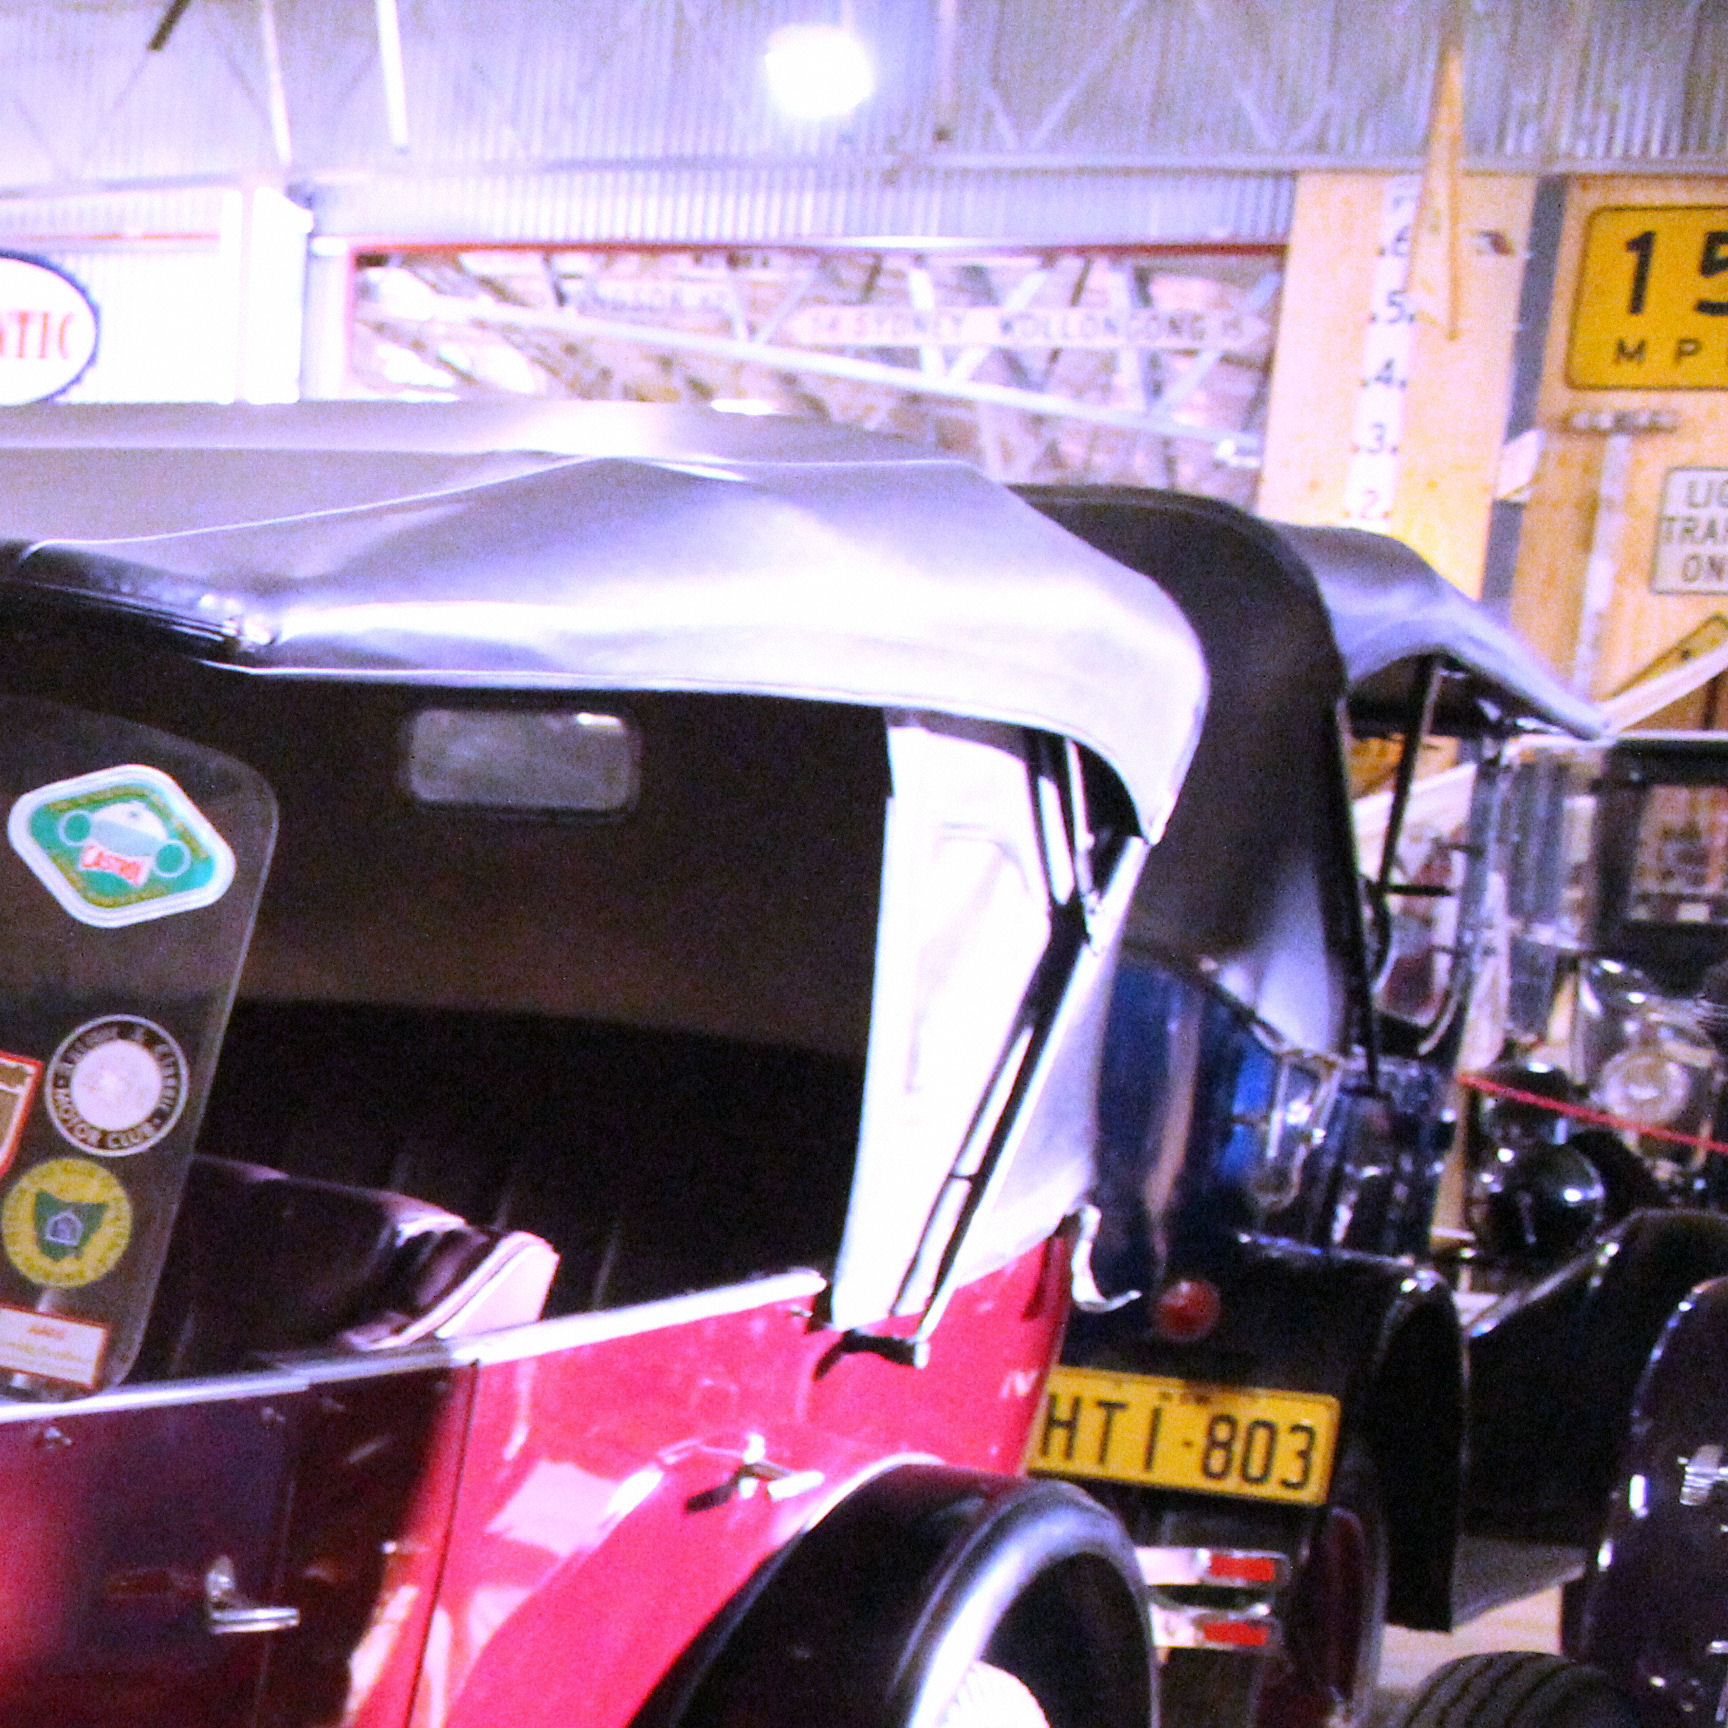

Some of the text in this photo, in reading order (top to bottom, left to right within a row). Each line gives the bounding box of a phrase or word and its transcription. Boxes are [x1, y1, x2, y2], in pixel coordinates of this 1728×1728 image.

[1626, 230, 1728, 316] 15
[1386, 289, 1408, 325] 5
[1374, 357, 1395, 389] 4
[1366, 421, 1386, 455] 3
[1359, 488, 1379, 520] 2
[53, 1087, 156, 1149] MOTOR CLUB
